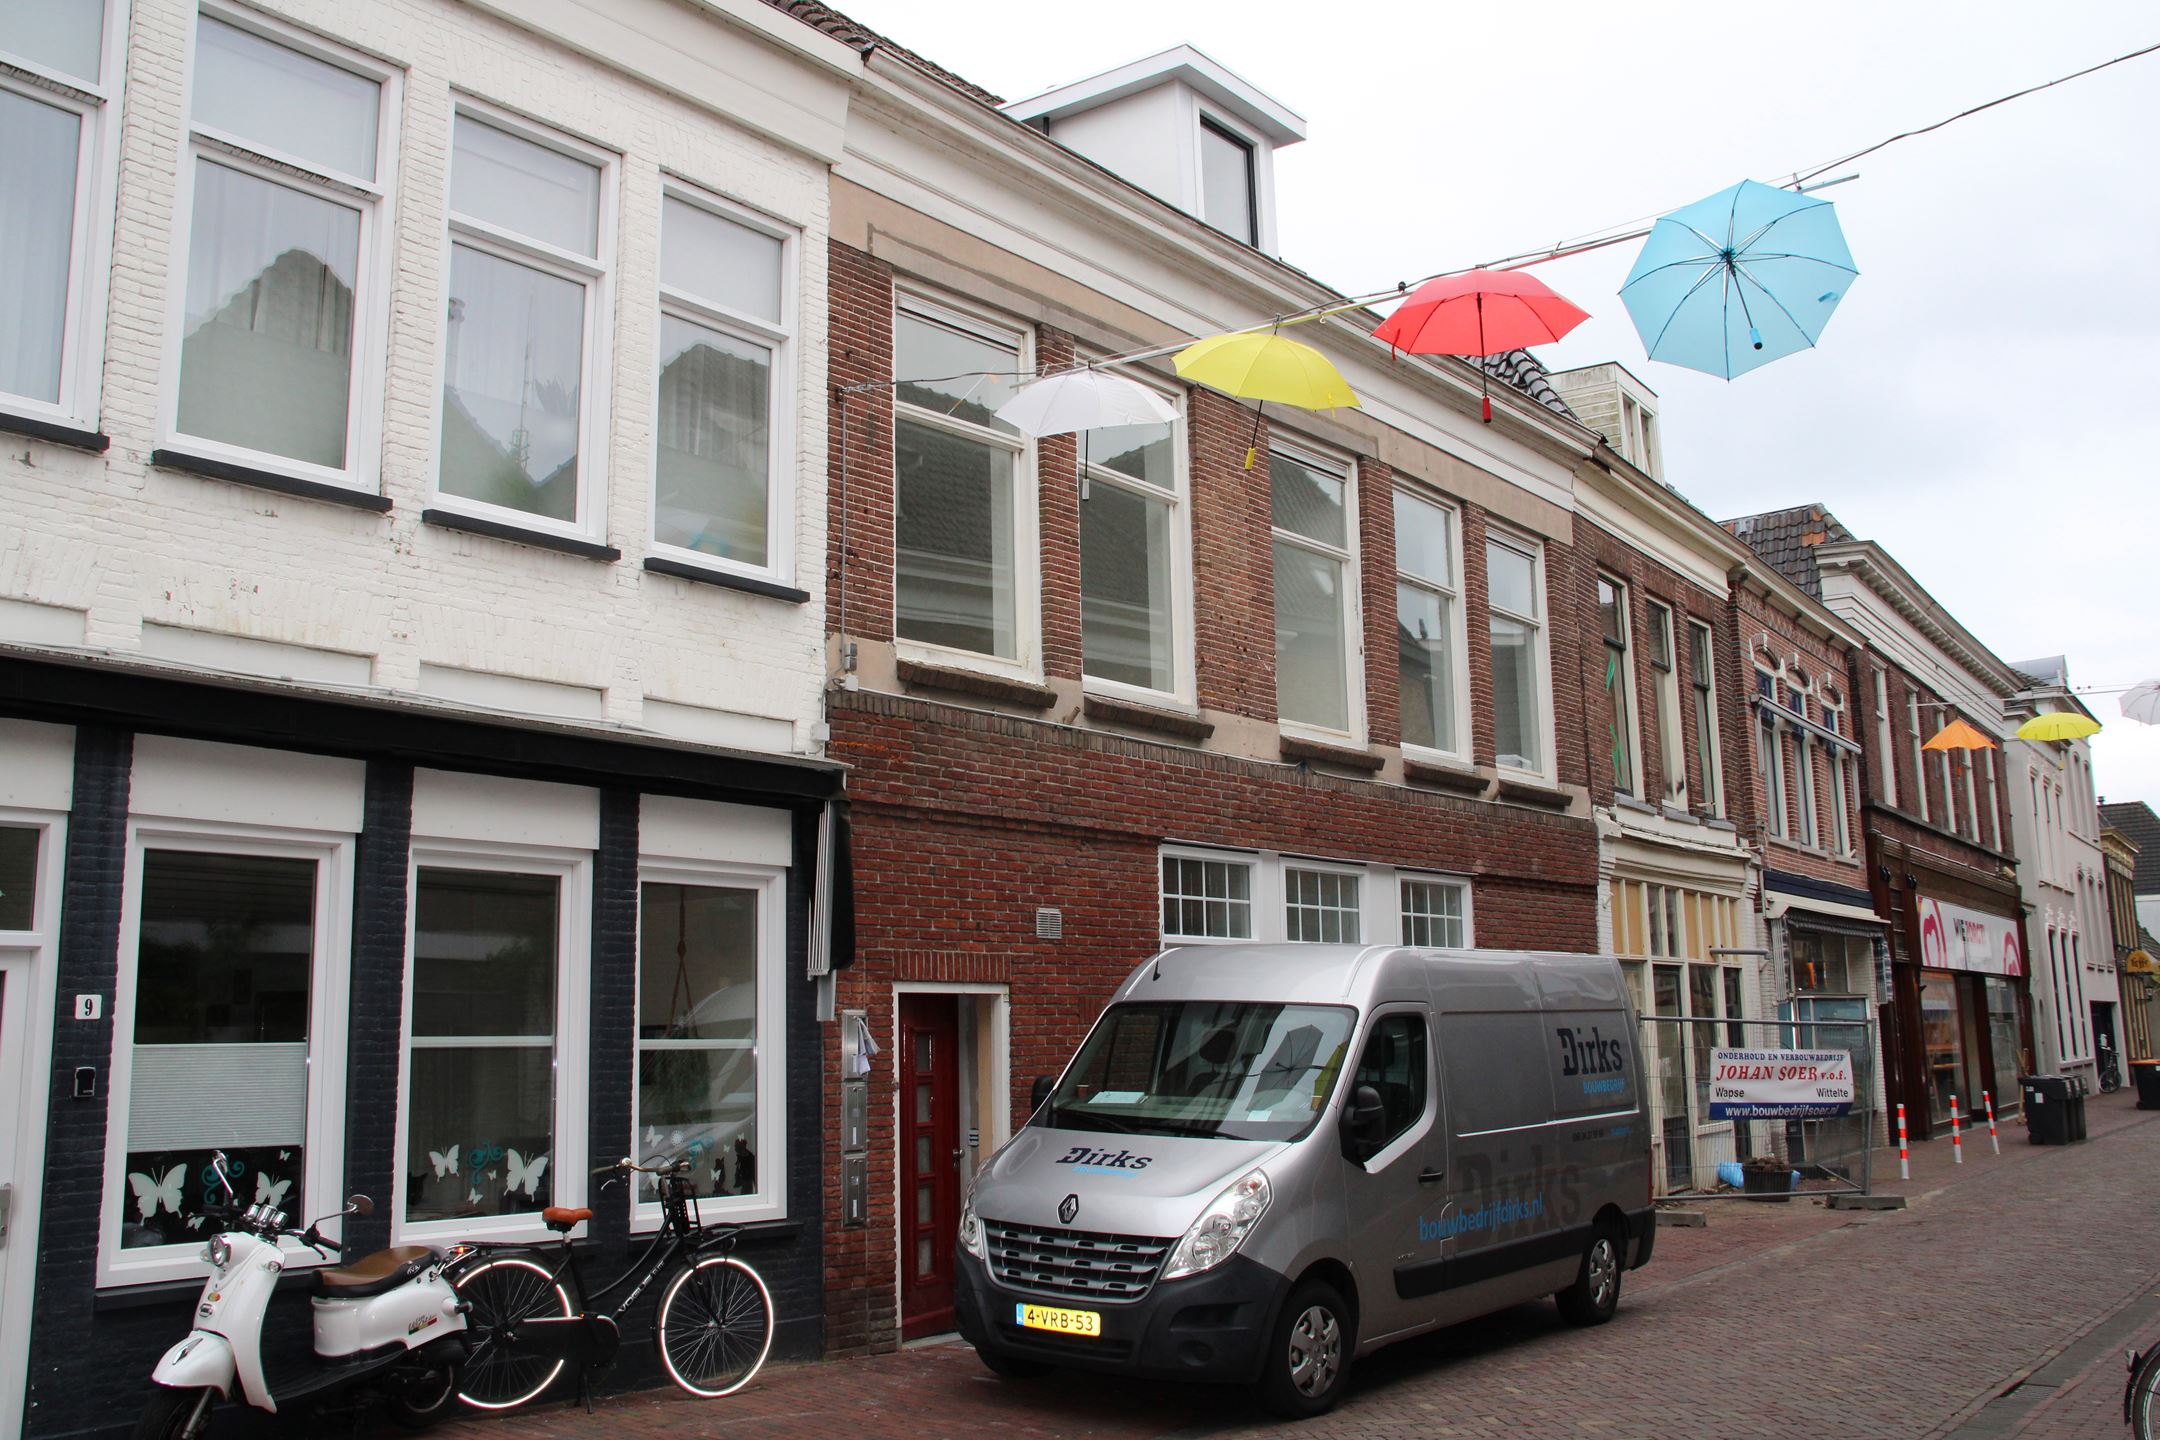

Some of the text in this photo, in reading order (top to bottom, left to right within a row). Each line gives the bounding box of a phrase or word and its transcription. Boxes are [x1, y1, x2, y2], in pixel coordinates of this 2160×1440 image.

[85, 998, 93, 1016] 9
[1557, 1027, 1623, 1076] Dirks
[1718, 1052, 1845, 1062] ONDERHOUD EN VERBOUWBEDRIJF
[1716, 1065, 1847, 1081] JOHAN SOER v.o.f.
[1715, 1087, 1745, 1099] Wapse
[1816, 1088, 1849, 1098] Wittelte
[1725, 1104, 1839, 1117] www.bouwbedrijfsoer.nl
[1056, 1147, 1152, 1169] Dirks
[1418, 1191, 1543, 1241] bouwbedrijfdirks.nl
[1027, 1308, 1093, 1331] 4-VRB-53
